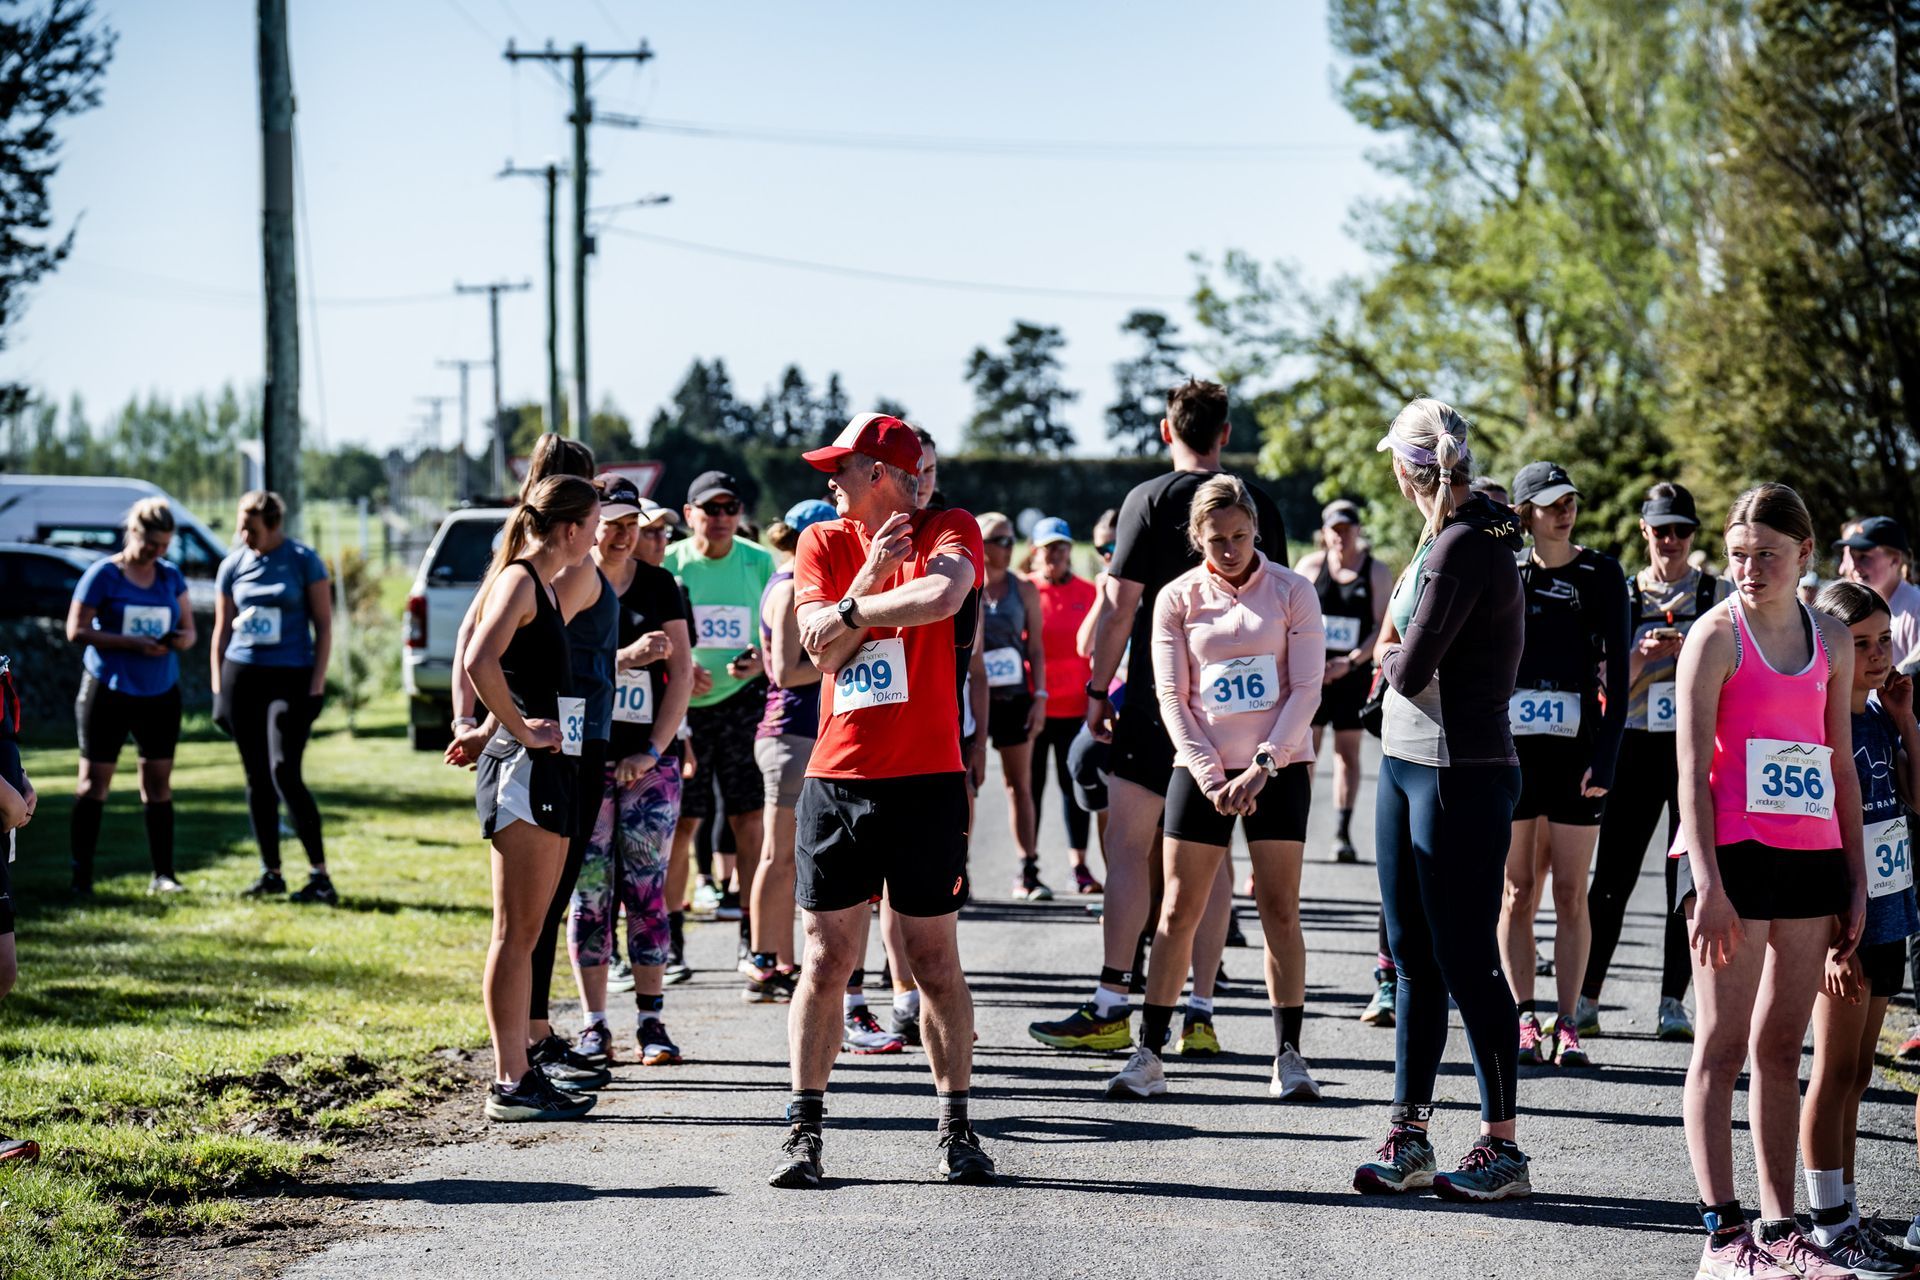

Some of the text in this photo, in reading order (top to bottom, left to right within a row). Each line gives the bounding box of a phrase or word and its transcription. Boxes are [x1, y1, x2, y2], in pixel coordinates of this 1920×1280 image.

[702, 619, 741, 638] 335
[842, 660, 892, 697] 309
[1213, 673, 1265, 702] 316
[872, 691, 902, 703] 10km
[1657, 697, 1676, 719] 3
[1520, 700, 1564, 723] 341
[1550, 723, 1573, 735] 10km
[1762, 763, 1824, 800] 356
[1805, 801, 1830, 815] 10km
[1876, 839, 1910, 877] 347
